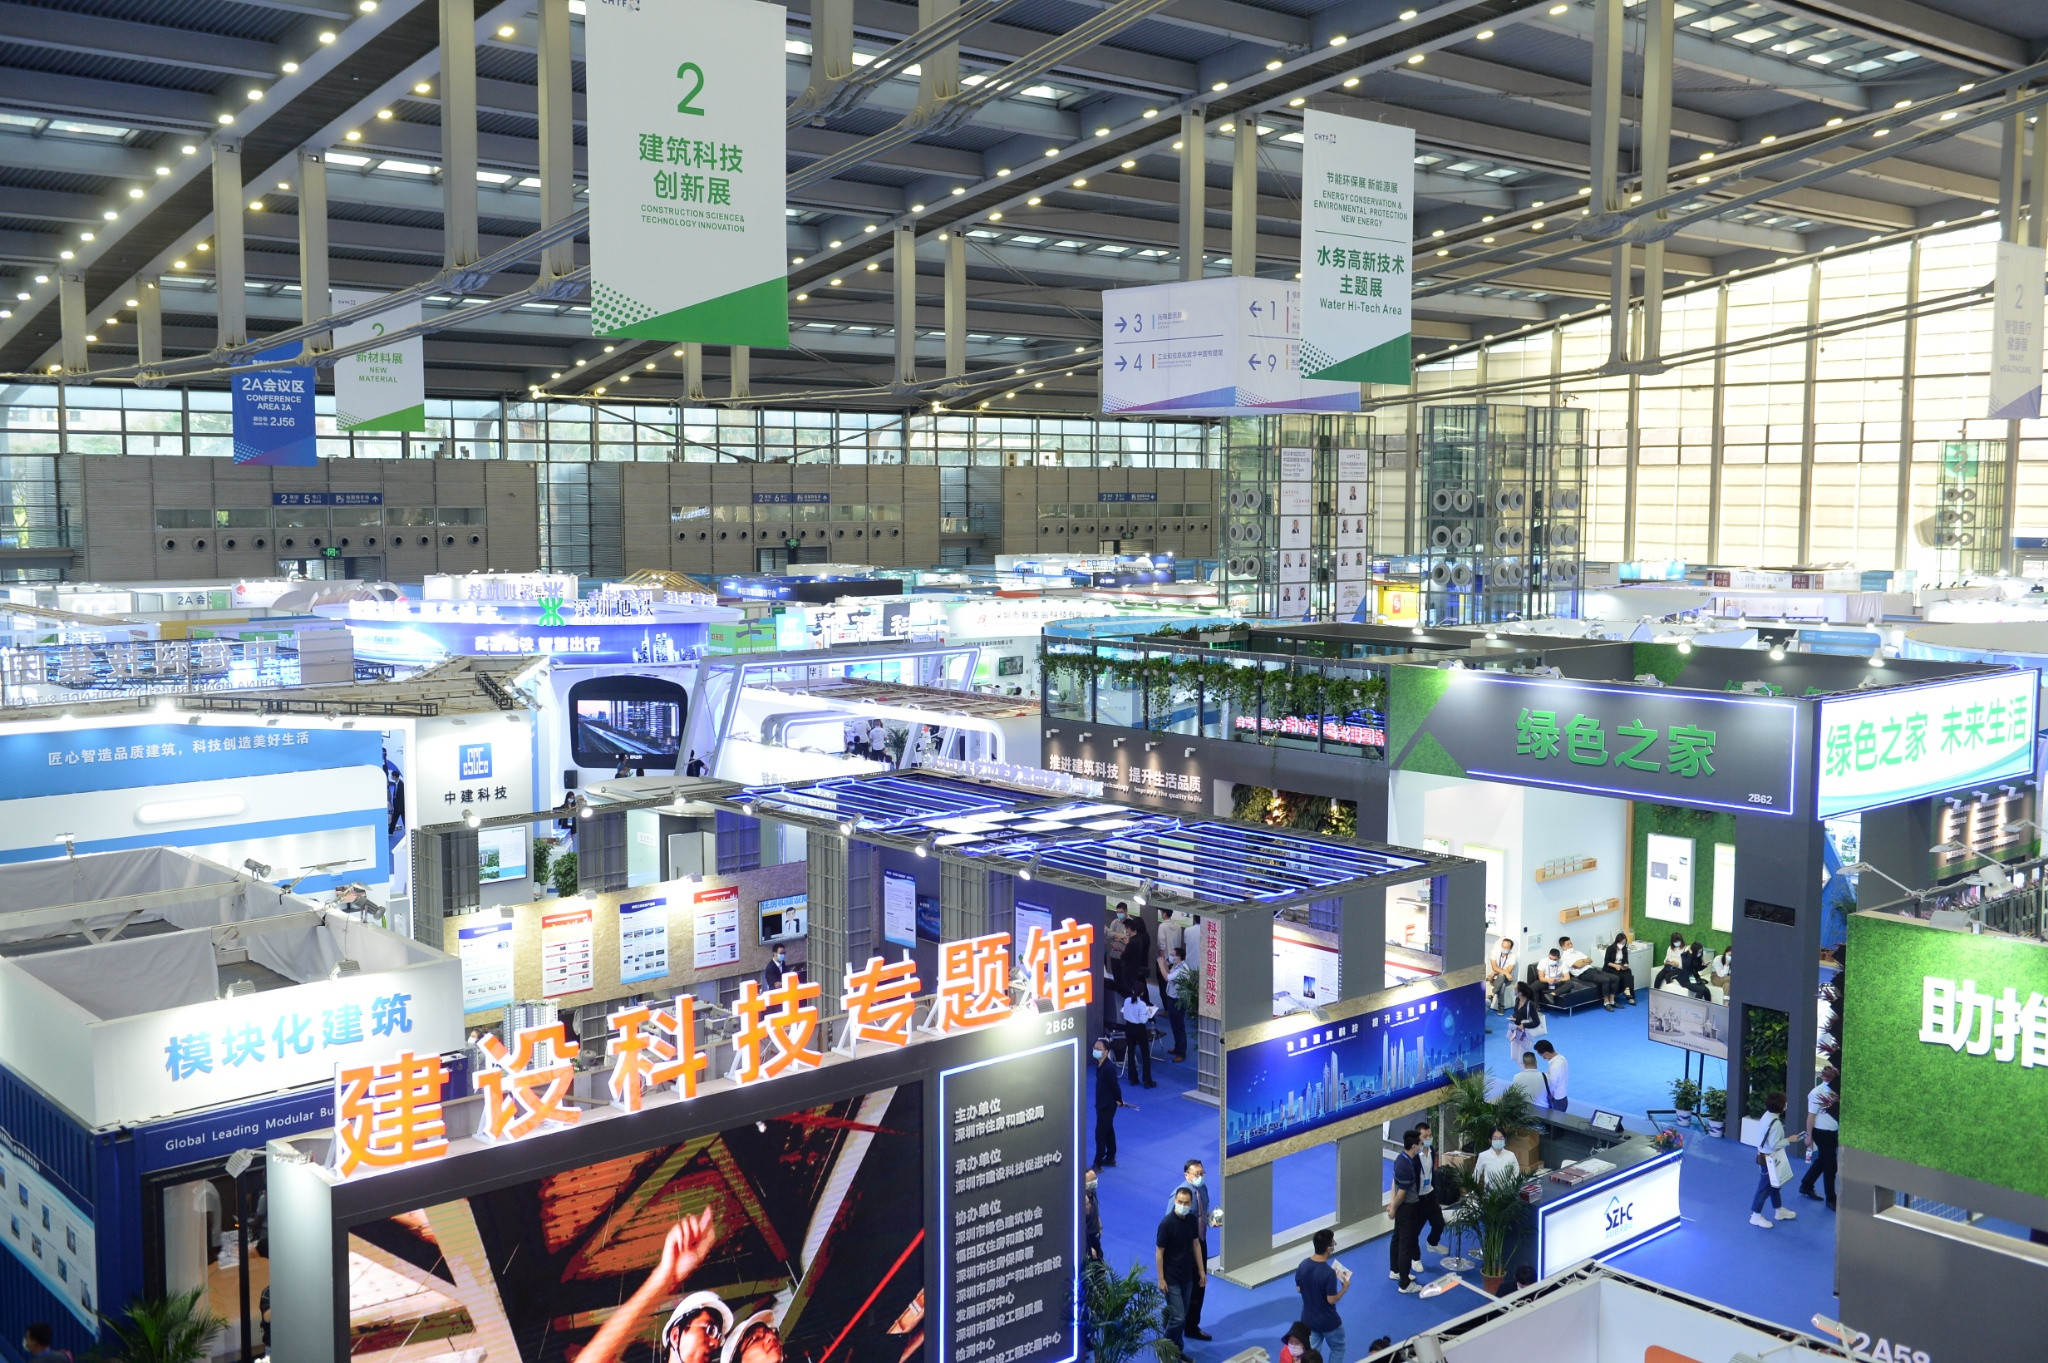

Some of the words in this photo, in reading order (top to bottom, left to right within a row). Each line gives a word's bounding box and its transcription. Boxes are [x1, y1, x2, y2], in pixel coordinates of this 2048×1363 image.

[677, 62, 705, 116] 2
[639, 133, 743, 174] 建筑科技
[653, 170, 731, 206] 创新展
[1327, 172, 1366, 189] 节能环保展
[1368, 178, 1398, 193] 新能源展
[1314, 200, 1367, 214] ENVIRONMENTAL
[1369, 208, 1408, 220] PROTECTION
[1322, 190, 1349, 201] ENERGY
[1350, 195, 1396, 207] CONSERVATION
[641, 204, 704, 218] CONSTRUCTION
[706, 211, 745, 222] SCIENCE&
[641, 215, 697, 228] TECHNOLOGY
[698, 220, 745, 233] INNOVATION
[1341, 215, 1356, 223] NEW
[1357, 217, 1383, 227] ENERGY
[1317, 245, 1405, 275] 水务高新技术
[1340, 274, 1383, 298] 主题展
[2015, 283, 2023, 309] 2
[1320, 297, 1346, 310] Water
[1348, 301, 1381, 314] Hi-Tech
[1383, 304, 1402, 316] Area
[1134, 313, 1143, 333] 3
[356, 351, 403, 364] 新材料展
[1134, 353, 1143, 372] 4
[1268, 354, 1277, 373] 9
[242, 377, 305, 393] 2A会议区
[359, 375, 398, 383] MATERIAL
[246, 394, 302, 404] CONFERENCE
[257, 403, 280, 411] AREA
[270, 417, 295, 427] 2J56
[1953, 450, 1969, 473] 2
[281, 494, 288, 504] 2
[304, 494, 310, 504] 5
[759, 495, 763, 503] 2
[2041, 538, 2048, 547] 2
[177, 596, 193, 605] 2A
[48, 741, 183, 766] 匠心智造品质建筑，
[192, 731, 310, 754] 科技创造美好生活
[1517, 707, 1716, 777] 绿色之家
[1825, 711, 1928, 777] 绿色之家
[1941, 695, 2027, 753] 未来生活
[1050, 754, 1119, 780] 推进建筑科技
[1129, 766, 1202, 793] 提升生活品质
[444, 786, 508, 805] 中建科技
[1748, 793, 1772, 805] 2B62
[1206, 921, 1217, 1005] 科技创新成效
[1045, 1017, 1074, 1035] 2B68
[1919, 976, 2048, 1069] 助推
[164, 993, 412, 1082] 模块化建筑
[340, 918, 1094, 1178] 建设科技专题馆
[955, 1098, 1001, 1124] 主办单位
[955, 1105, 1044, 1142] 深圳市住房和建设局
[165, 1131, 206, 1151] Global
[212, 1121, 259, 1145] Leading
[265, 1109, 314, 1130] Modular
[955, 1149, 1001, 1174] 承办单位
[955, 1150, 1062, 1194] 深圳市建设科技促进中心
[955, 1199, 1001, 1226] 协办单位
[1606, 1202, 1633, 1231] SZHC
[955, 1206, 1043, 1245] 深圳市绿色建筑协会
[955, 1223, 1044, 1264] 福田区住房和建设局
[955, 1246, 1034, 1284] 深圳市住房保障署
[955, 1255, 1062, 1303] 深圳市房地产和城市建设
[955, 1291, 1015, 1323] 发展研究中心
[955, 1300, 1043, 1342] 深圳市建设工程质量
[955, 1337, 996, 1362] 检测中心
